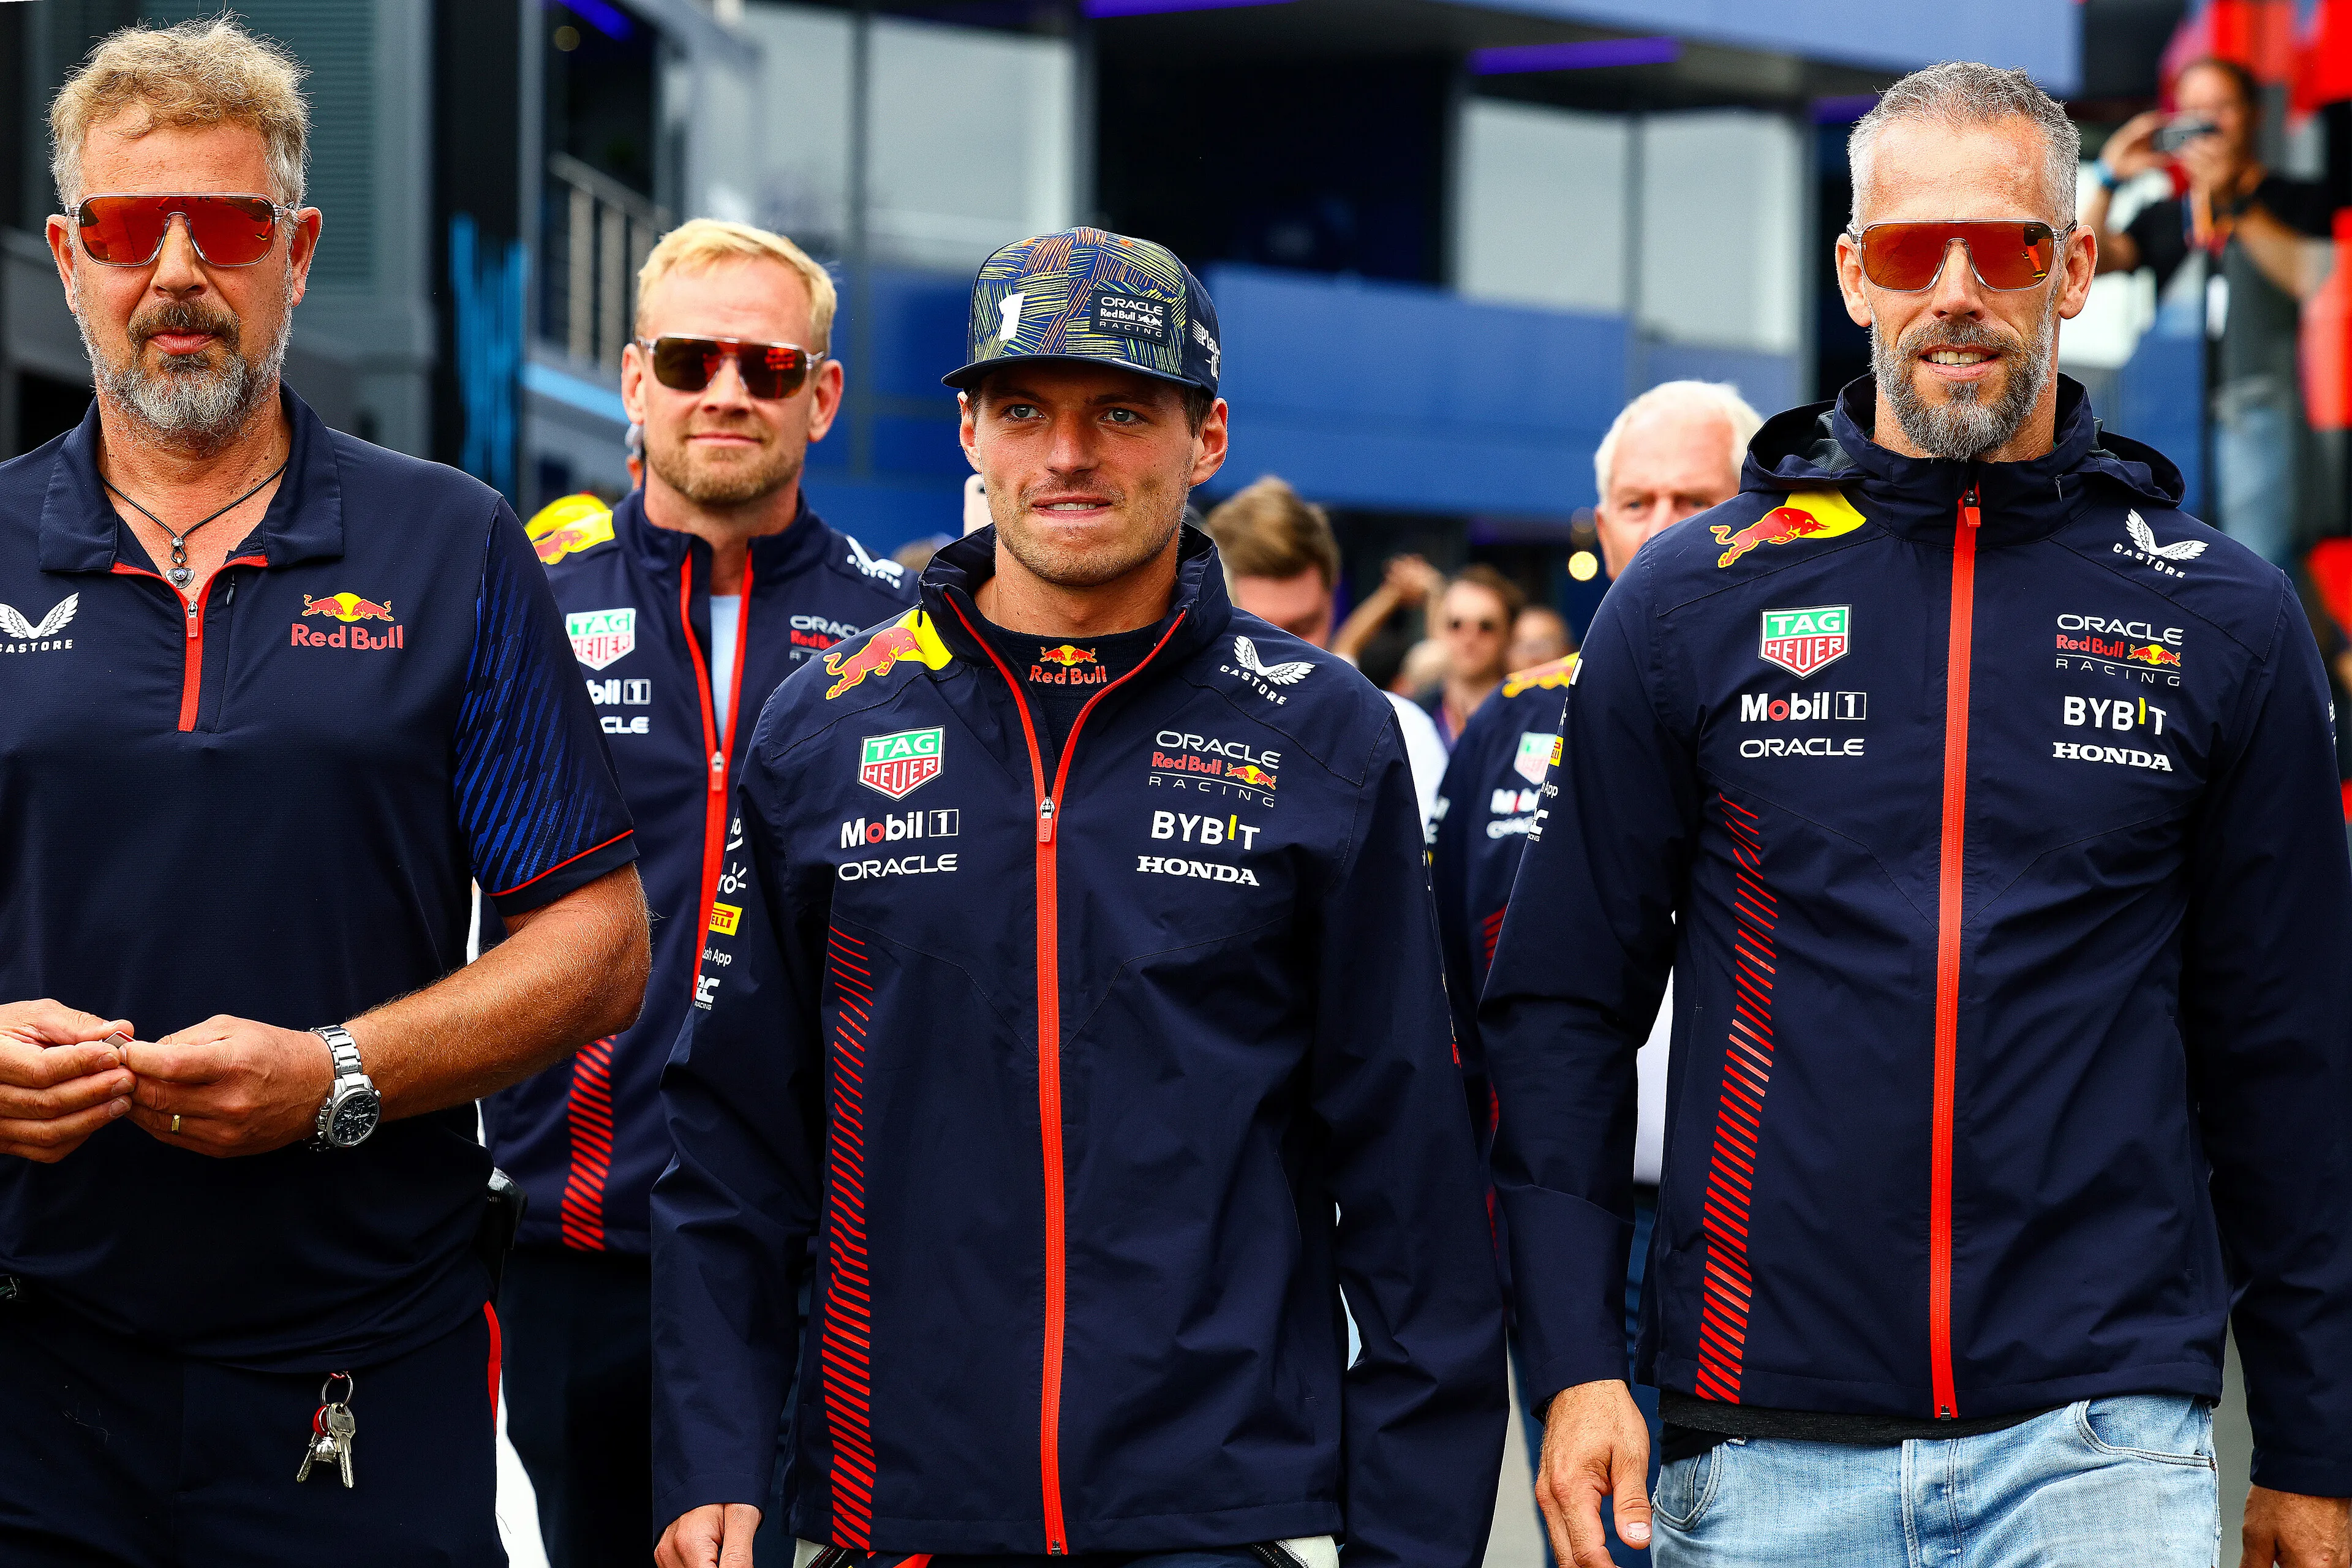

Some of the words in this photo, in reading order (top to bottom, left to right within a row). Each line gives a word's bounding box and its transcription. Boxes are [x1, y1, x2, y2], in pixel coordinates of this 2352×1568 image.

[998, 292, 1025, 342] 1
[1100, 308, 1118, 318] Red
[1118, 309, 1136, 320] Bull
[1101, 296, 1164, 316] ORACLE
[1099, 322, 1162, 337] RACING
[2113, 543, 2186, 579] CASTORE
[291, 623, 347, 648] Red
[351, 625, 404, 650] Bull
[573, 614, 628, 634] TAG
[790, 615, 860, 638] ORAC
[1771, 612, 1841, 635] TAG
[2057, 614, 2184, 646] ORACLE
[1767, 638, 1842, 671] HEUER
[2056, 635, 2090, 652] Red
[2092, 638, 2125, 658] Bull
[1029, 665, 1067, 684] Red
[1070, 665, 1107, 685] Bull
[1219, 665, 1287, 705] CASTORE
[2056, 658, 2180, 687] RACING
[586, 679, 621, 705] bil
[1741, 692, 1830, 722] Mobil
[2063, 695, 2167, 735] BYBIT
[600, 715, 650, 734] CLE
[870, 734, 935, 761] TAG
[1156, 730, 1282, 770] ORACLE
[1740, 737, 1865, 758] ORACLE
[2052, 742, 2173, 772] HONDA
[865, 758, 936, 792] HEUER
[1151, 751, 1188, 770] Red
[1188, 755, 1223, 775] Bull
[1148, 775, 1275, 809] RACING
[1544, 780, 1558, 799] App
[840, 810, 924, 850] Mobil
[1151, 810, 1261, 851] BYBIT
[838, 853, 959, 881] ORACLE
[1136, 855, 1261, 887] HONDA
[710, 908, 734, 929] ELLI
[712, 948, 732, 967] App
[694, 1001, 712, 1011] RACING
